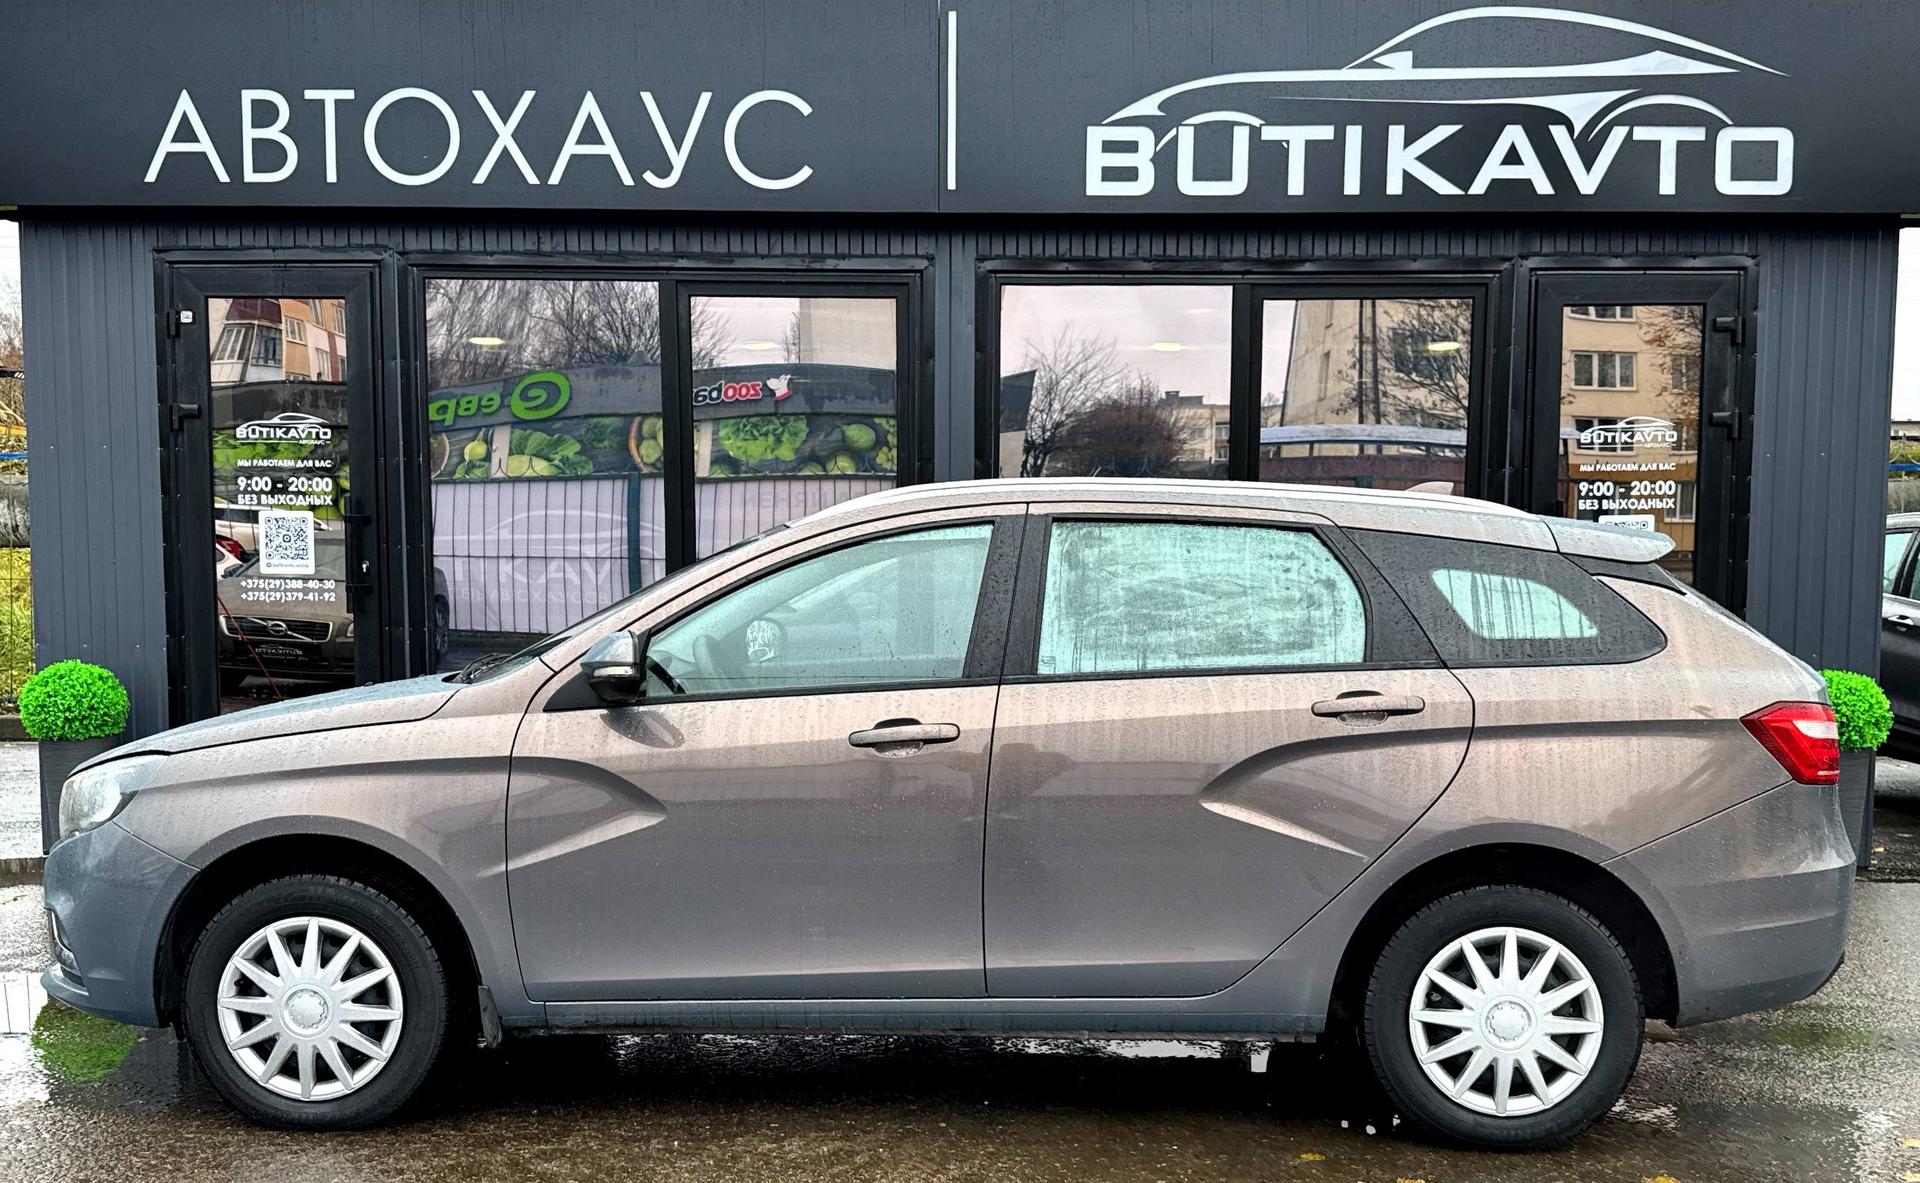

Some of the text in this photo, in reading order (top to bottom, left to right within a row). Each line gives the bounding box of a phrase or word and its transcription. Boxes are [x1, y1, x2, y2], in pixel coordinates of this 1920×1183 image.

[144, 87, 814, 190] АВТОХАУС
[1086, 124, 1794, 197] BUTIKAVTO
[236, 426, 331, 439] BUTIKAVTO
[1580, 431, 1678, 443] BUTIKAVTO
[237, 459, 251, 467] МЫ
[253, 459, 295, 467] РАБОТАЕМ
[296, 459, 313, 468] ДЛЯ
[1580, 463, 1676, 472] МЫ РАБОТАЕМ ДЛЯ ВАС
[237, 476, 272, 492] 9:00
[288, 477, 333, 492] 20:00
[1579, 481, 1614, 497] 9:00
[1630, 480, 1676, 496] 20:00
[237, 494, 333, 506] БЕЗ ВЫХОДНЫХ
[1578, 498, 1675, 510] БЕЗ ВЫХОДНЫХ
[240, 578, 336, 590] +375(29)388-40-30
[240, 591, 336, 603] +375(29)379-41-92
